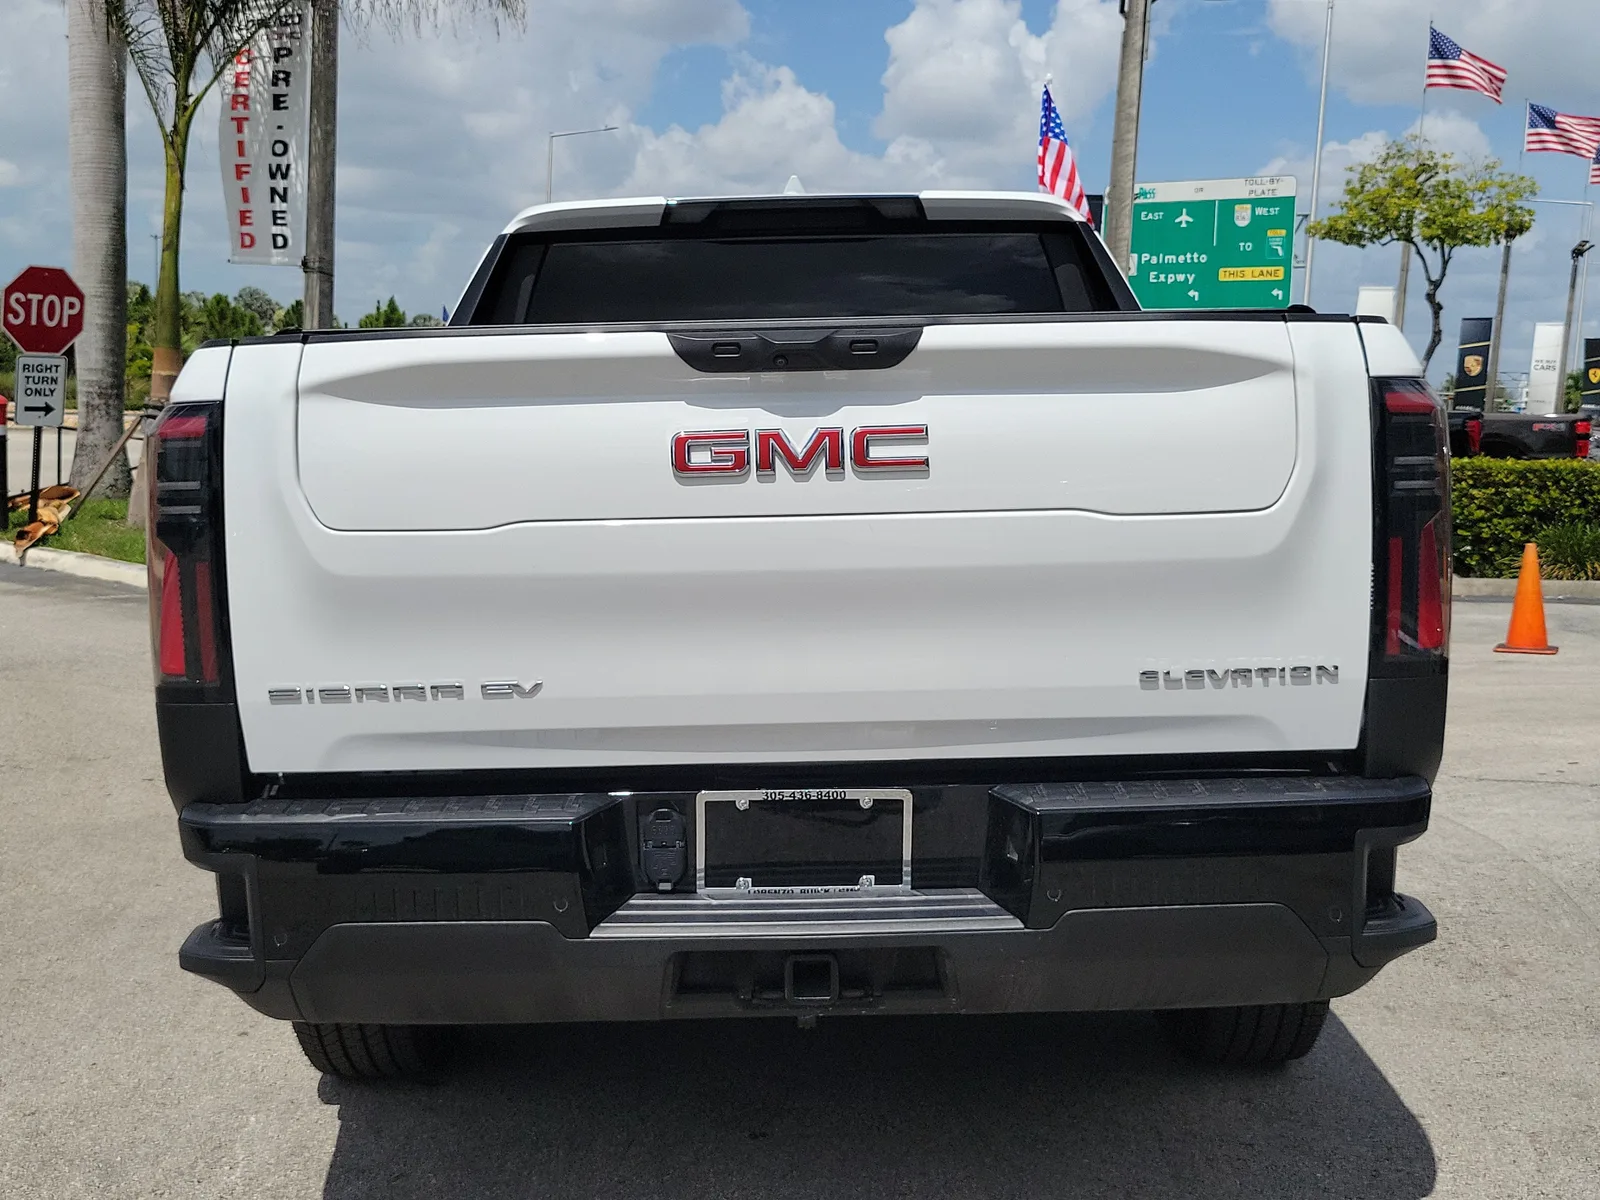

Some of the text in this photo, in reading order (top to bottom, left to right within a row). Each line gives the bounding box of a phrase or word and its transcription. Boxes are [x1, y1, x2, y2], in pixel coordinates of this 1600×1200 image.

[230, 48, 257, 250] CERTIFIED
[268, 46, 293, 250] PRE-OWNED
[1248, 188, 1278, 197] PLATE
[1254, 207, 1281, 216] WEST
[1238, 242, 1253, 252] TO
[1140, 252, 1208, 265] Palmetto
[1149, 271, 1196, 285] Expwy
[1221, 268, 1281, 279] THIS LANE
[7, 291, 82, 328] STOP
[22, 363, 61, 375] RIGHT
[1533, 364, 1557, 372] CARS
[24, 375, 59, 386] TURN
[24, 387, 57, 398] ONLY
[671, 424, 930, 478] GMC
[1139, 664, 1340, 690] ELEVATION
[268, 679, 544, 704] SIERRA EV
[761, 790, 847, 801] 305-436-8400
